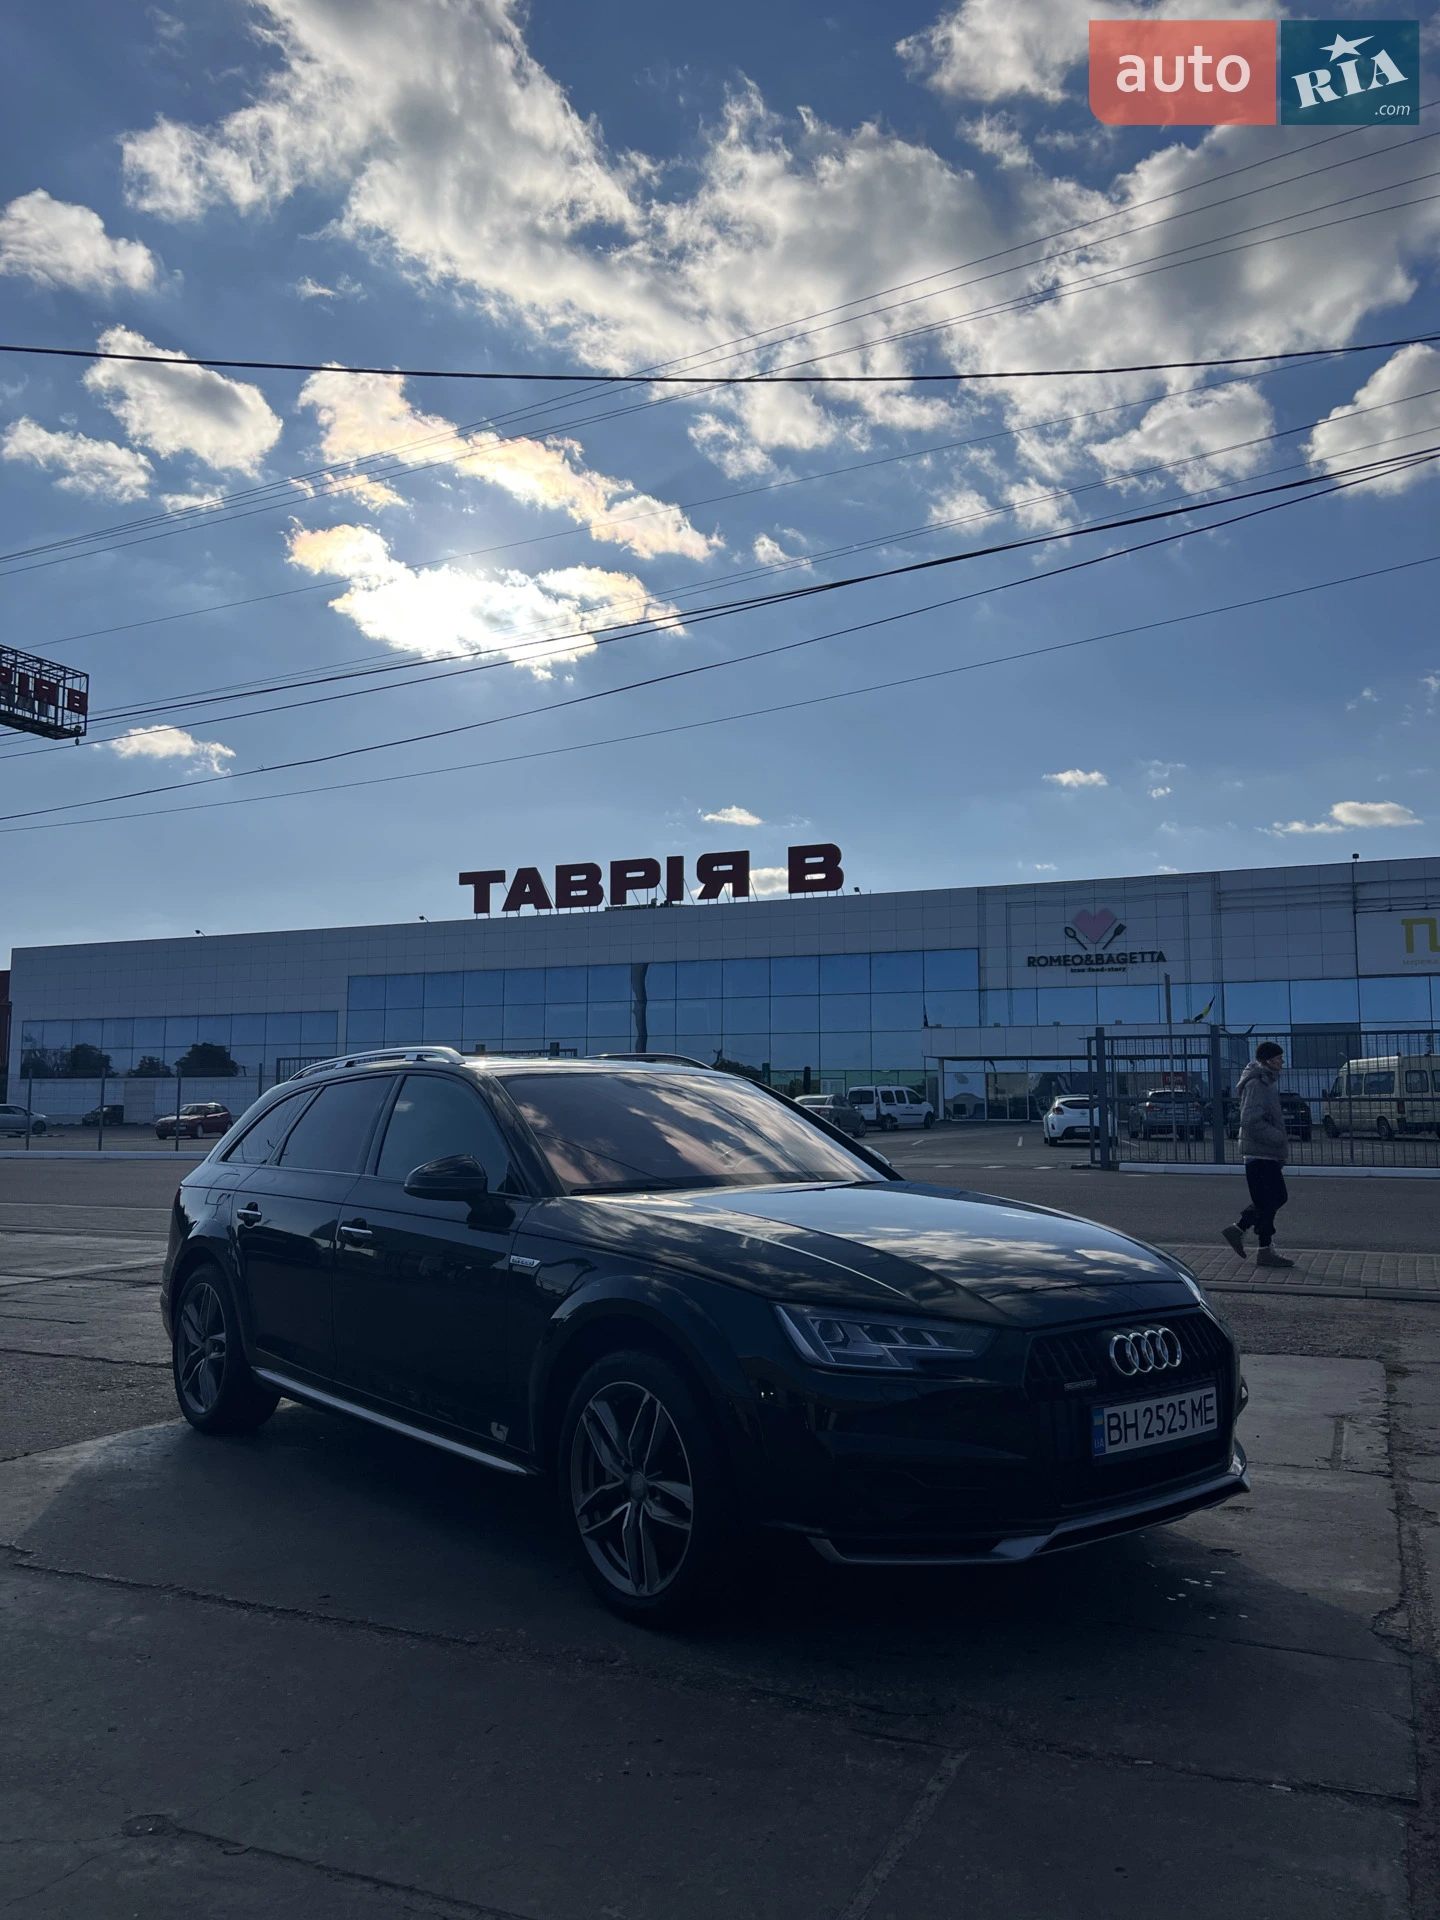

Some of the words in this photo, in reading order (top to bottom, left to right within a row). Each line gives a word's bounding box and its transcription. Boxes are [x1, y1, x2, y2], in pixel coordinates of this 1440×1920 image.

[458, 850, 750, 914] ТАВРІЯ
[788, 843, 844, 894] В
[1027, 951, 1167, 967] ROMEO&BAGETTA
